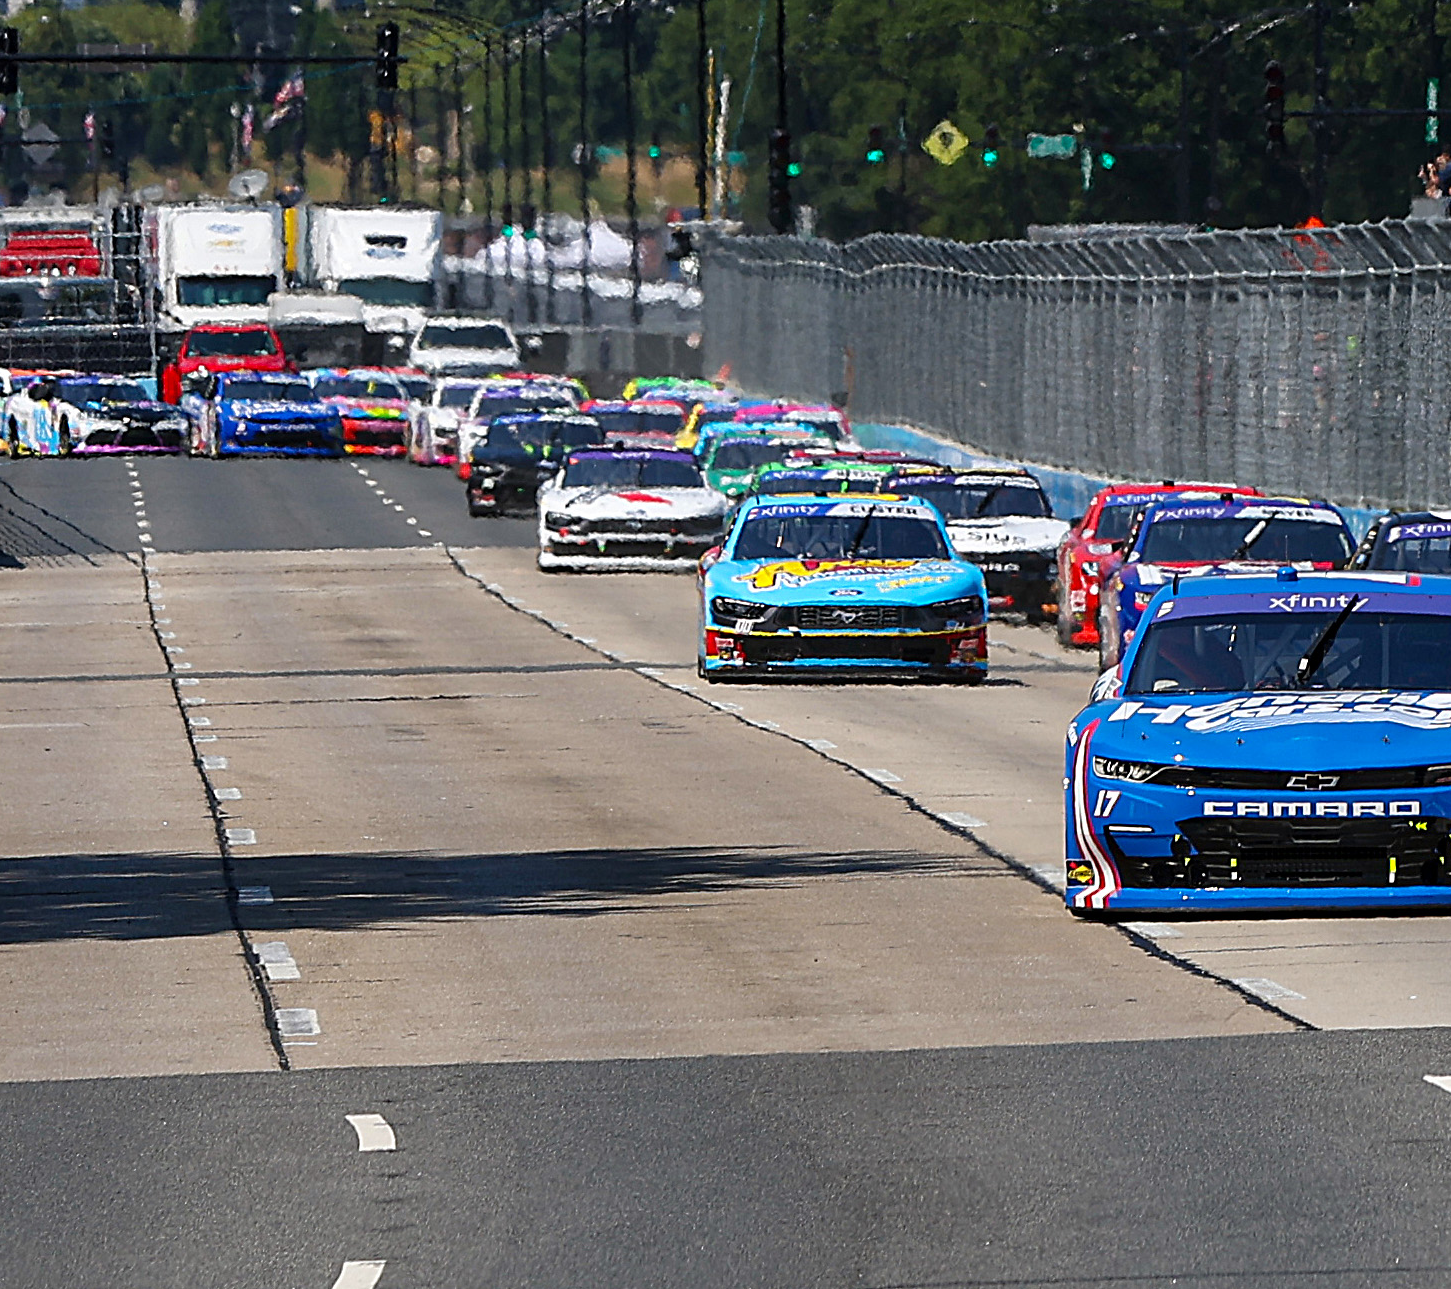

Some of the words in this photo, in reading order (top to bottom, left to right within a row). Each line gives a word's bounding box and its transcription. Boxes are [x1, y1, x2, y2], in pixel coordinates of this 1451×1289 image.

[760, 505, 819, 518] xfinity
[849, 505, 918, 516] CUSTER
[1166, 507, 1226, 519] xfinity
[1094, 790, 1121, 817] 17
[1203, 801, 1421, 817] CAMARO
